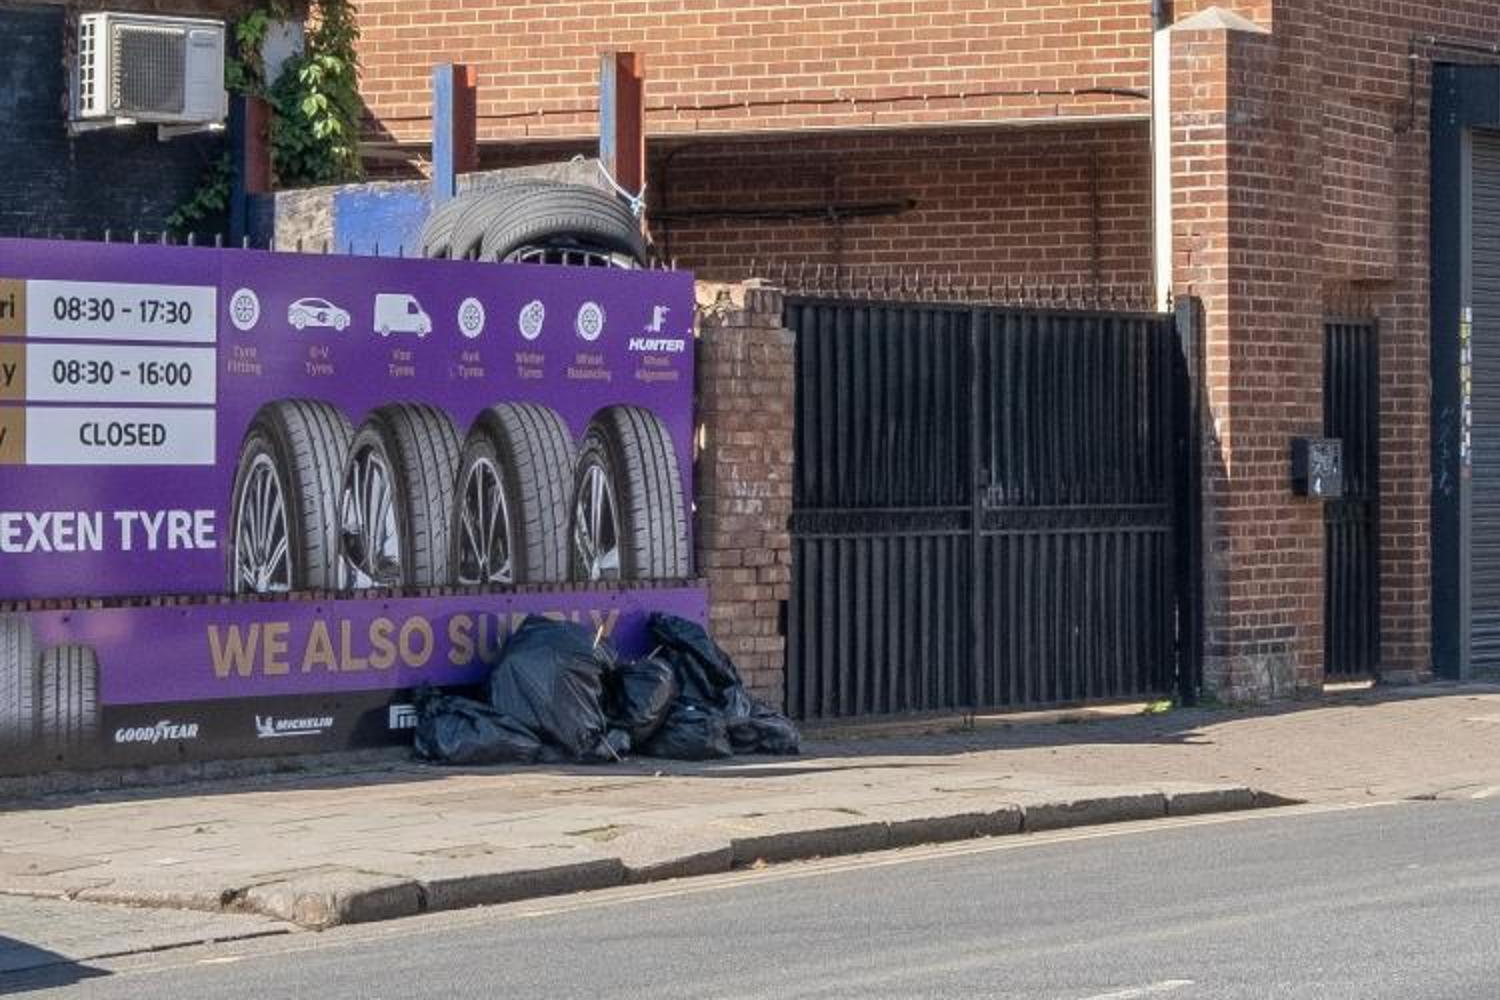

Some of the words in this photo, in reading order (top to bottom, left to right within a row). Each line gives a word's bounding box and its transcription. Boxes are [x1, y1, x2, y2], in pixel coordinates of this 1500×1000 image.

[0, 293, 15, 319] ri
[53, 296, 114, 323] 08:30
[139, 299, 192, 325] 17:30
[628, 338, 686, 353] HUNTER
[52, 359, 114, 385] 08:30
[138, 362, 192, 386] 16:00
[79, 421, 167, 447] CLOSED
[0, 511, 103, 553] EXEN
[113, 510, 218, 551] TYRE
[208, 621, 290, 678] WE
[303, 615, 434, 673] ALSO
[447, 609, 621, 666] SUY
[115, 719, 199, 744] GOODYEAR
